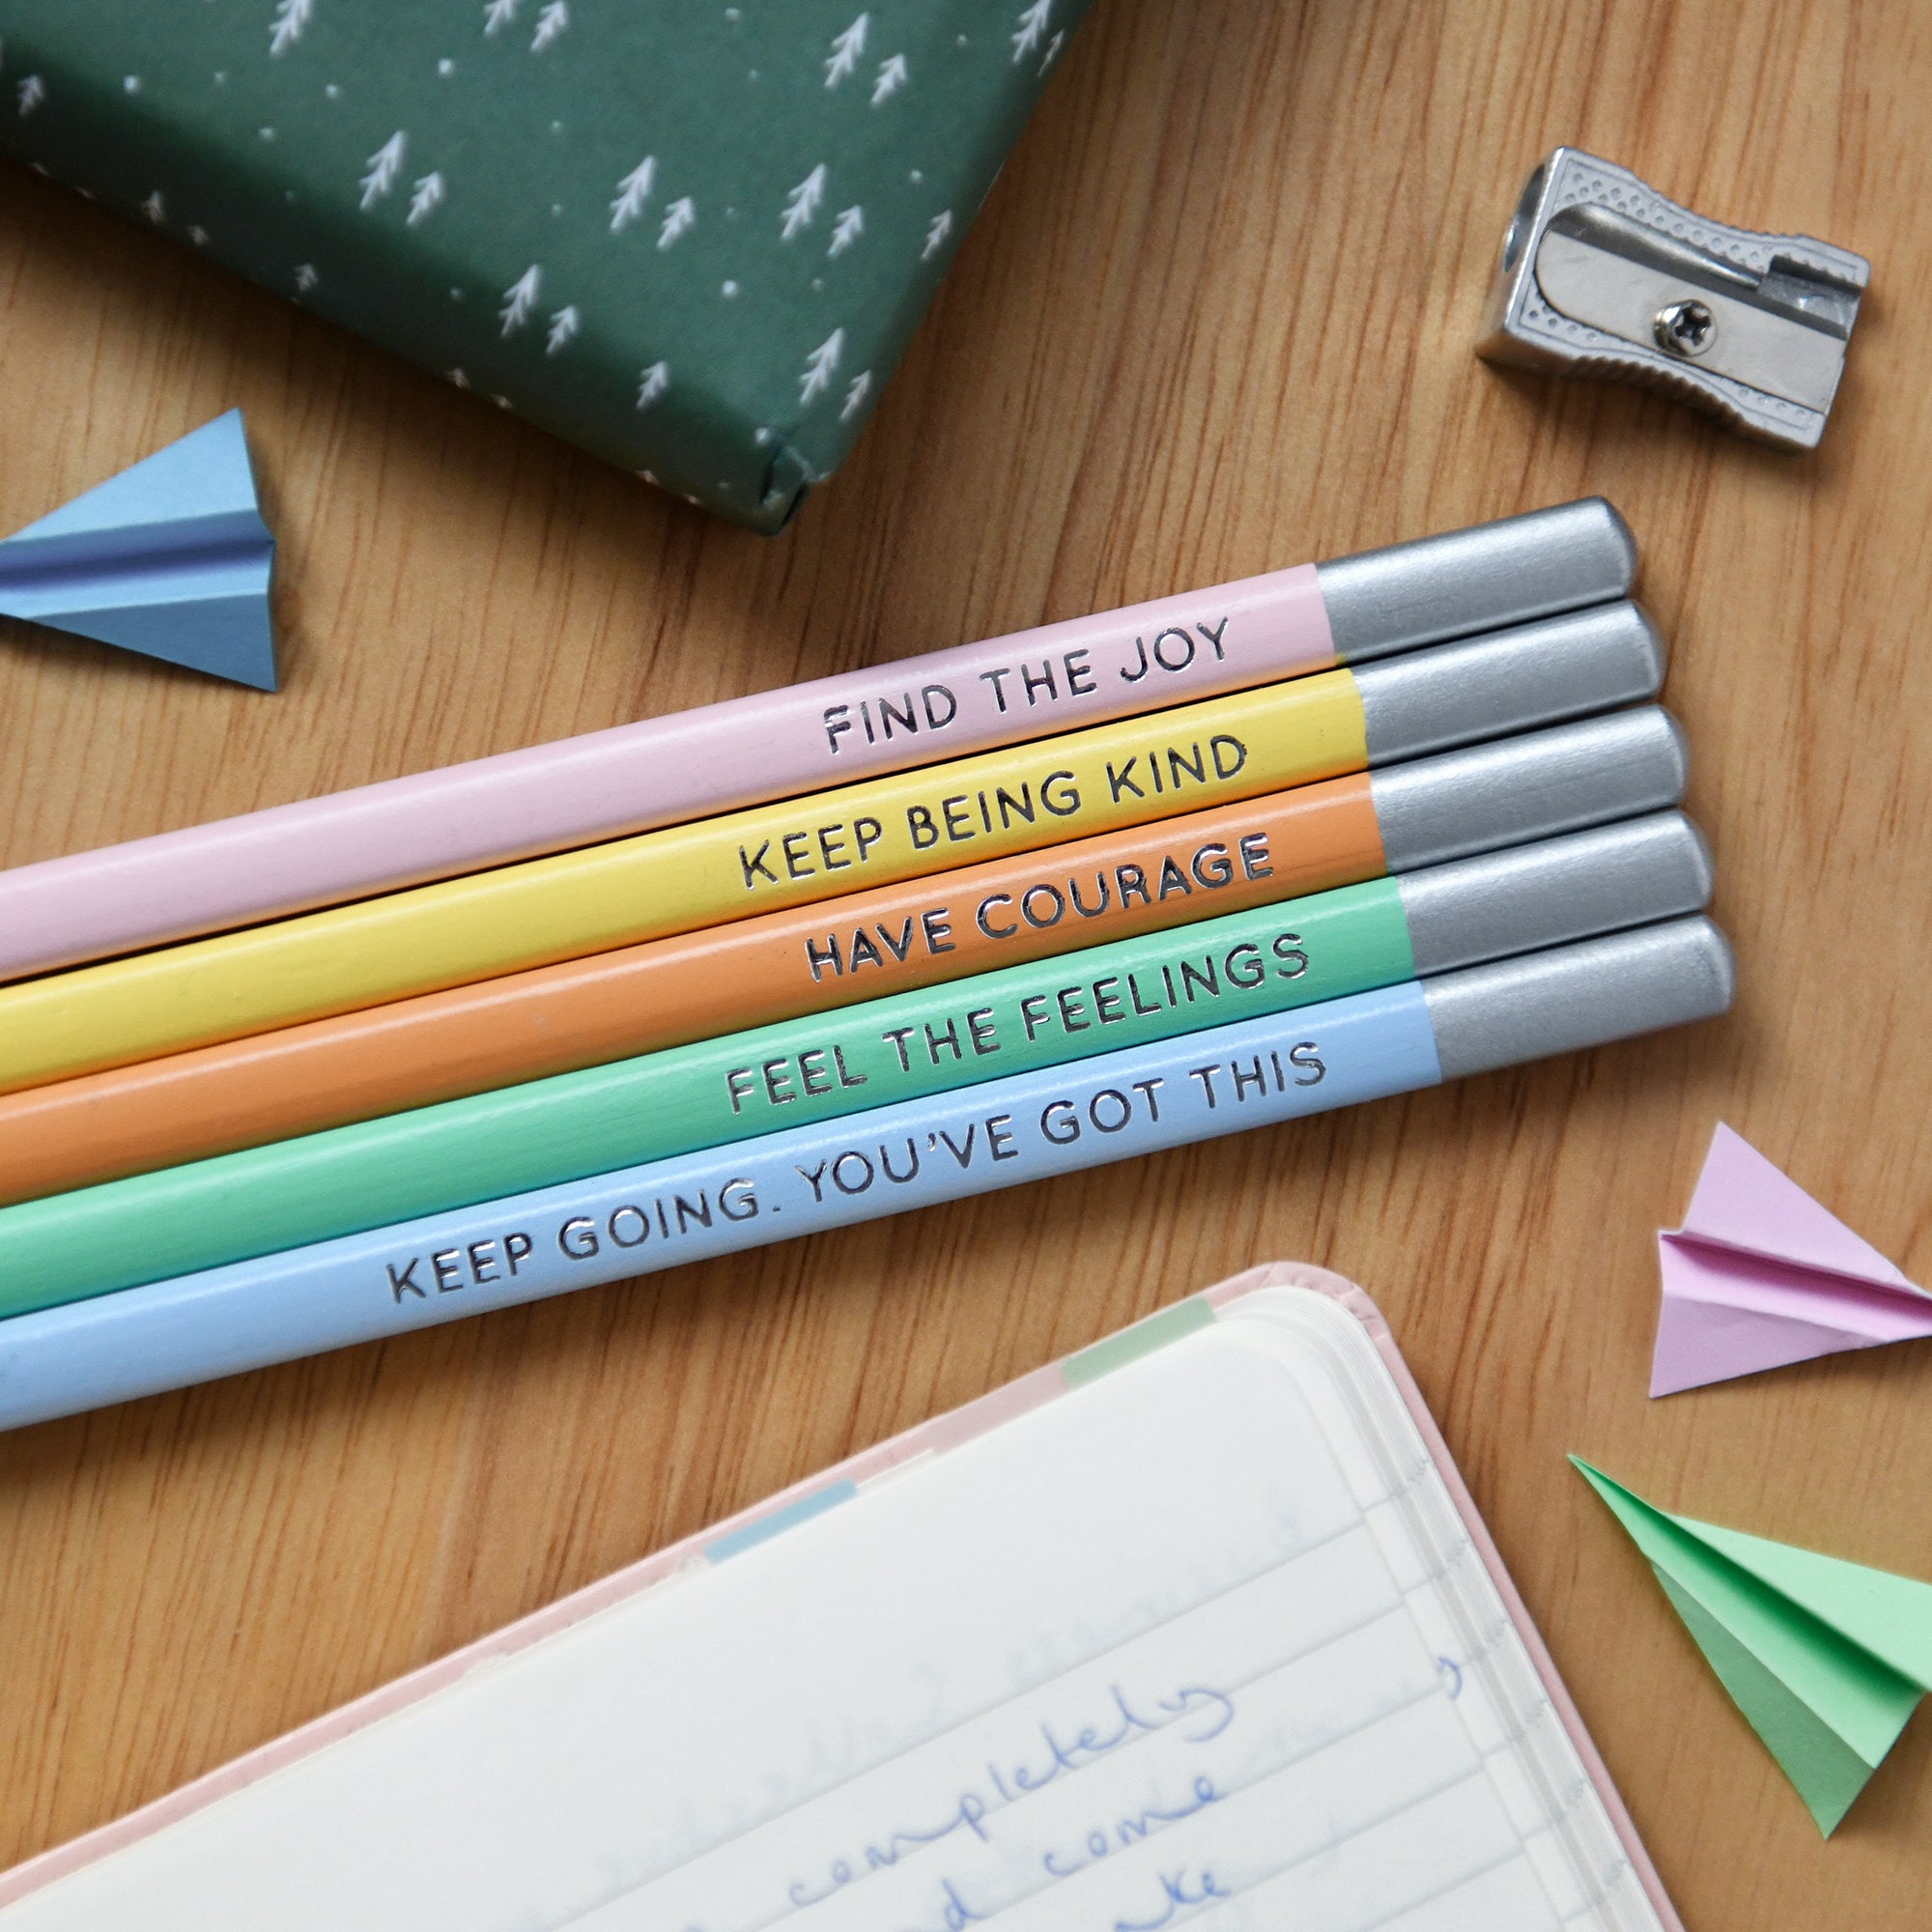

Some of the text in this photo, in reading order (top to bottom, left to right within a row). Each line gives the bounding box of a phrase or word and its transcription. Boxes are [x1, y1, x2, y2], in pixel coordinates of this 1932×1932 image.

[823, 616, 1230, 753] FIND THE JOY
[738, 734, 1247, 890] KEEP BEING KIND
[805, 832, 1273, 982] HAVE COURAGE
[724, 933, 1309, 1115] FEEL THE FEELINGS
[385, 1042, 1327, 1304] KEEP GOING. YOU'VE GOT THIS
[787, 1684, 1234, 1907] completely
[1043, 1775, 1220, 1877] come
